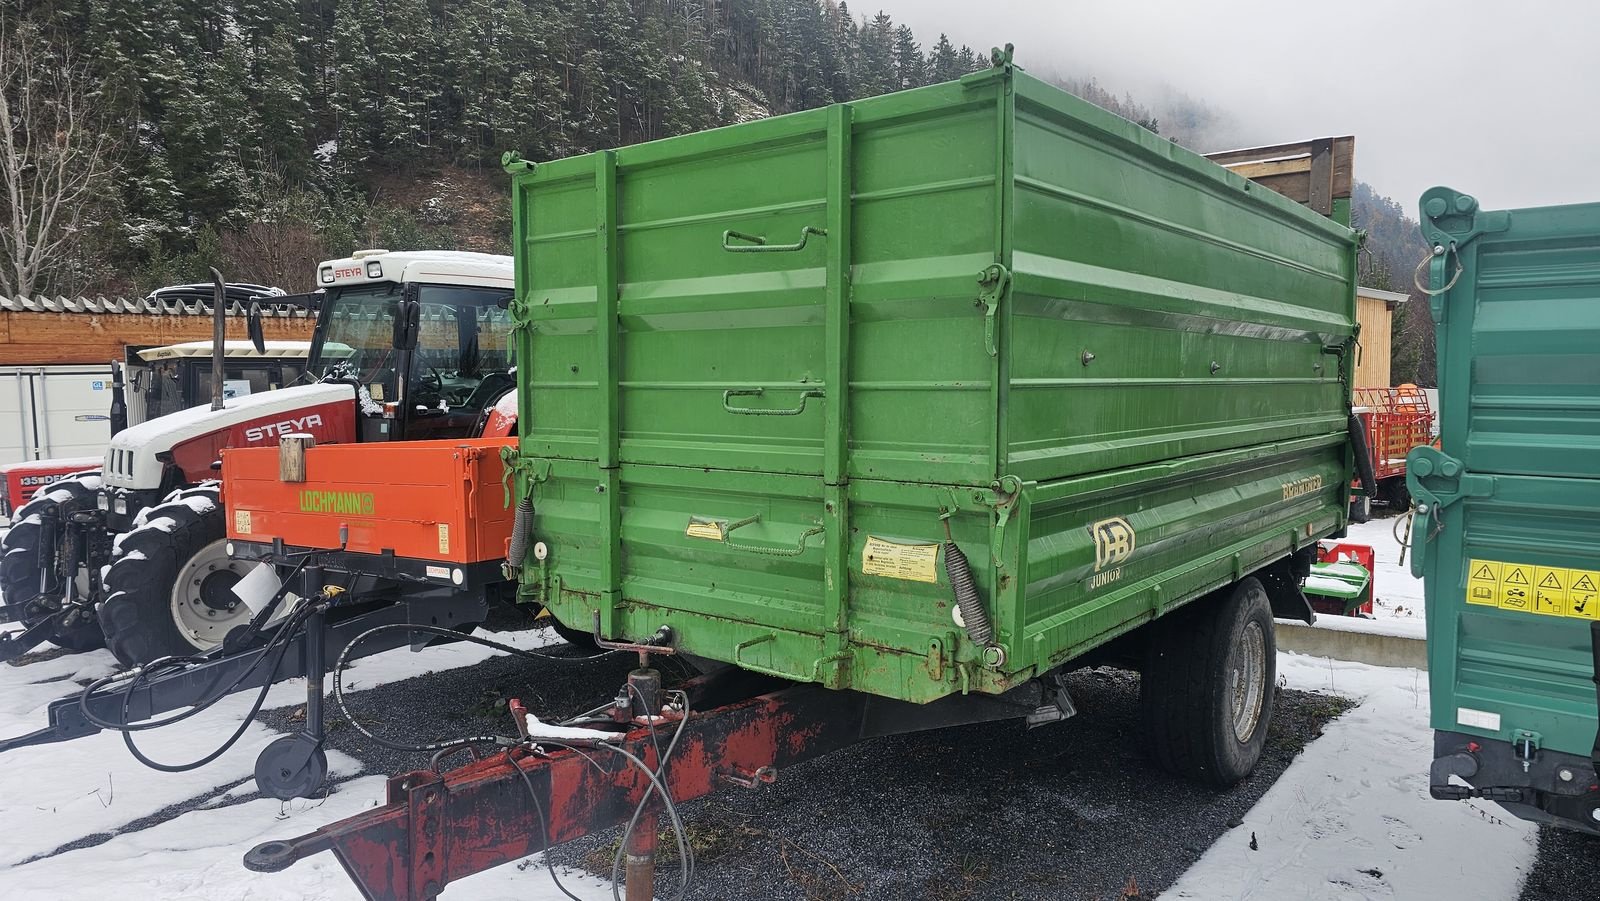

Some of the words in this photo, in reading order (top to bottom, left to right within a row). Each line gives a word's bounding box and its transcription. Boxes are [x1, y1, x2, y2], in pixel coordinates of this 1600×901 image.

[335, 267, 361, 278] STEYR
[245, 414, 323, 441] STEYR
[300, 490, 361, 514] LOCHMANN
[1090, 567, 1121, 589] JUNIOR
